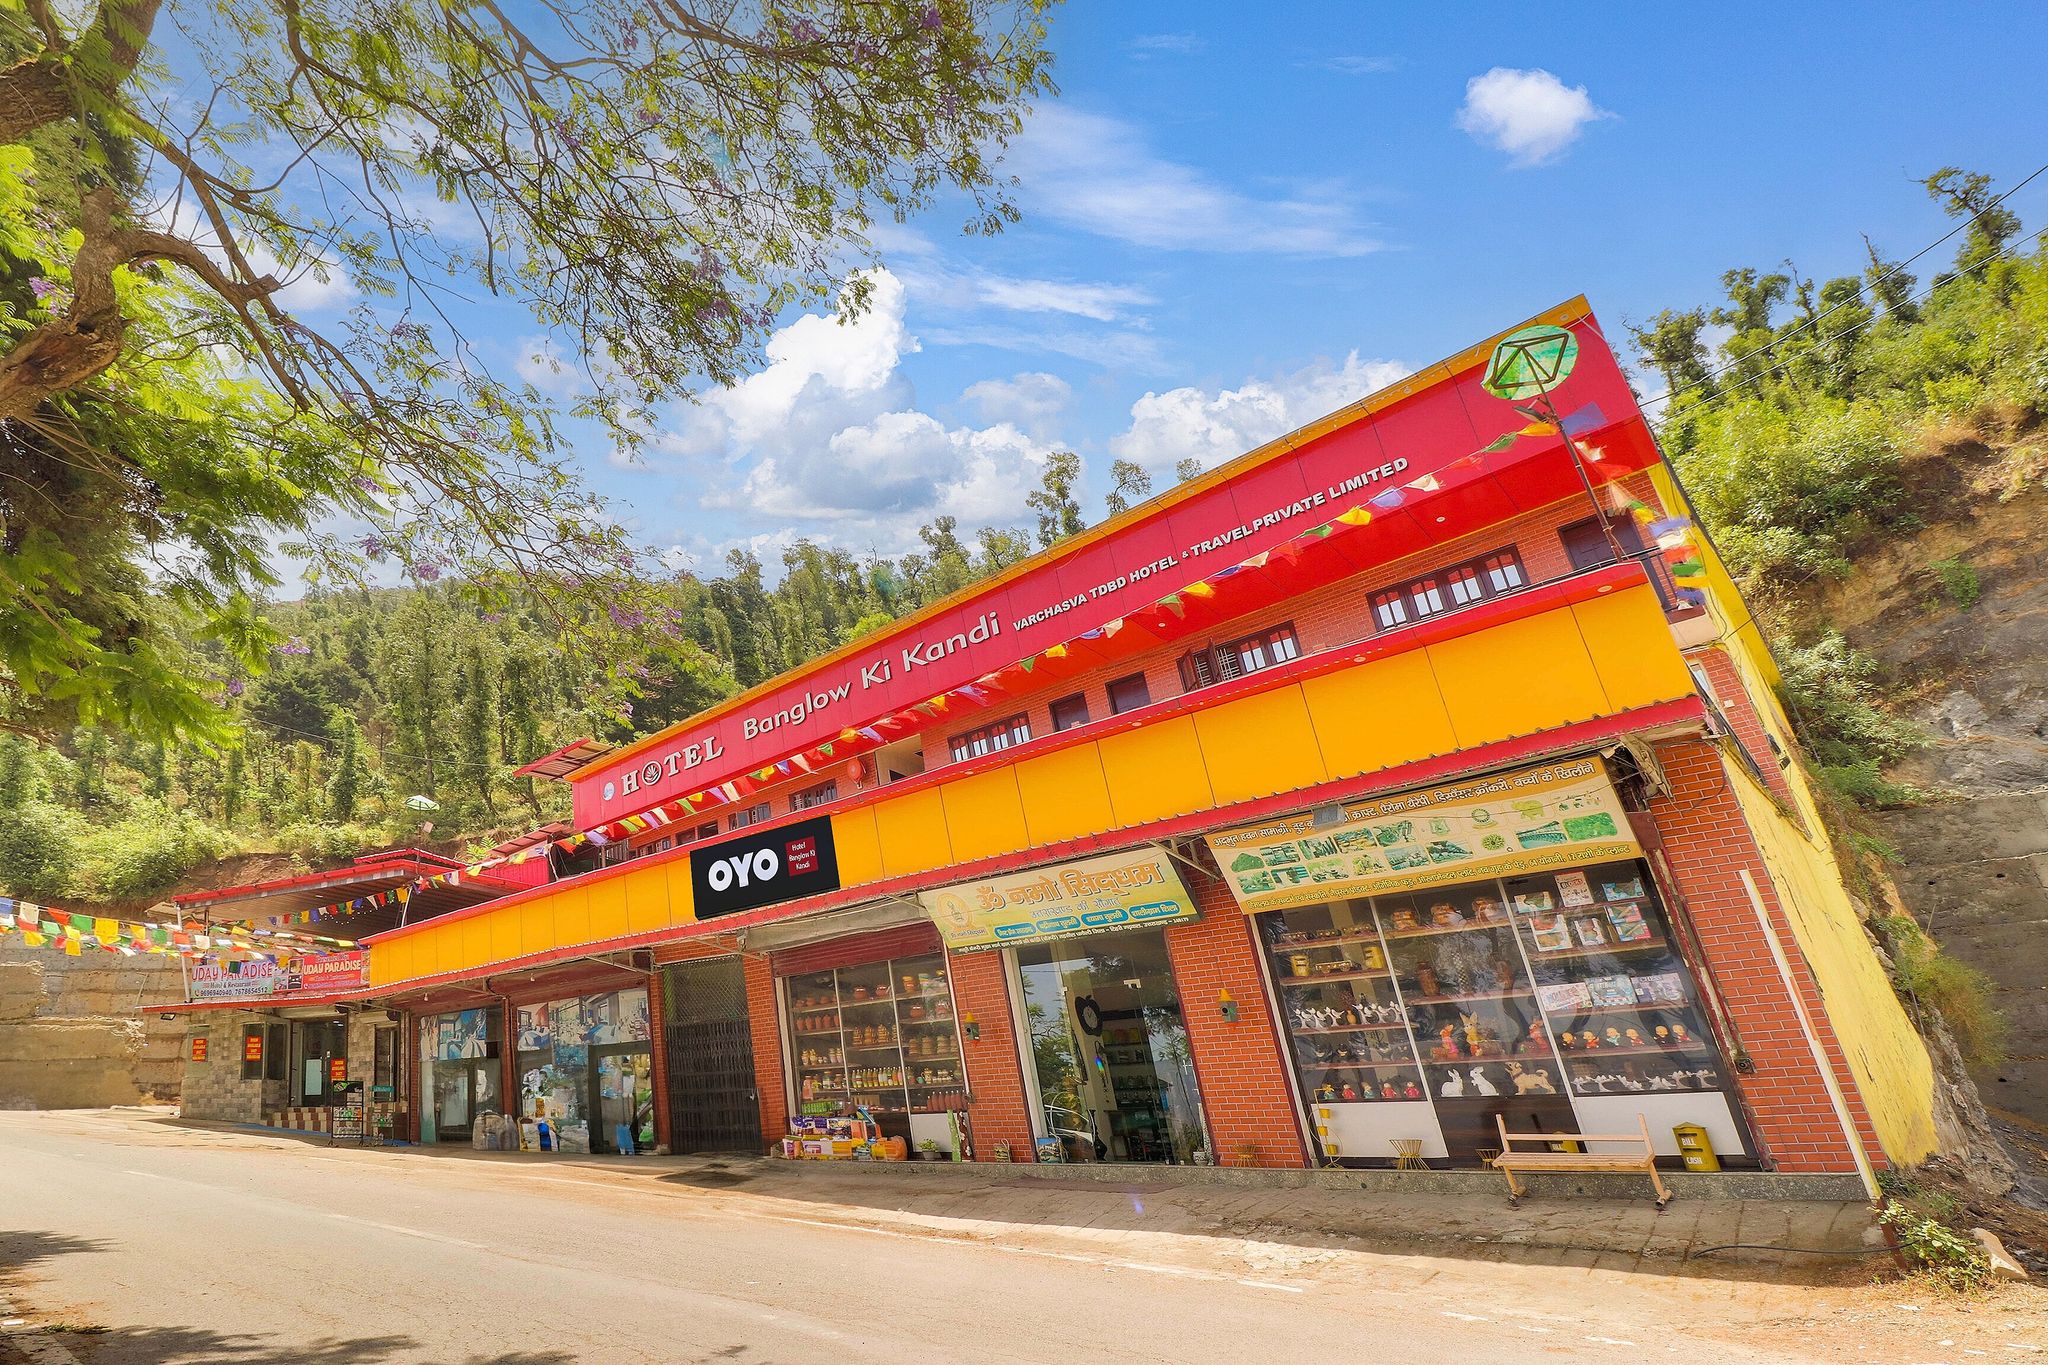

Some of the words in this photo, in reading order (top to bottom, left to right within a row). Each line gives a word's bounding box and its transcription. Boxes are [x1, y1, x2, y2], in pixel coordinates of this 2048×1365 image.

[1012, 593, 1088, 632] VARCHASVA
[1088, 576, 1127, 599] TDBD
[1129, 555, 1179, 584] HOTEL
[1181, 550, 1189, 559] &
[1190, 524, 1254, 557] TRAVEL
[1253, 492, 1326, 532] PRIVATE
[1328, 457, 1409, 500] LIMITED
[621, 736, 724, 796] HOTEL
[743, 681, 852, 740] Banglow
[860, 659, 892, 690] Ki
[901, 611, 1001, 673] Kandi
[1513, 772, 1540, 787] बच्चों
[1541, 769, 1552, 782] के
[1554, 762, 1596, 779] खिलौने
[791, 841, 806, 851] Hotel
[1595, 847, 1604, 856] के
[788, 853, 810, 863] Banglow
[809, 849, 816, 857] Ki
[708, 848, 779, 892] OYO
[795, 861, 811, 871] Kandi
[1005, 875, 1063, 907] नमो
[303, 963, 323, 975] UDAY
[323, 959, 361, 973] PARADISE
[1681, 1137, 1696, 1146] BILL
[1686, 1156, 1703, 1165] CASH
